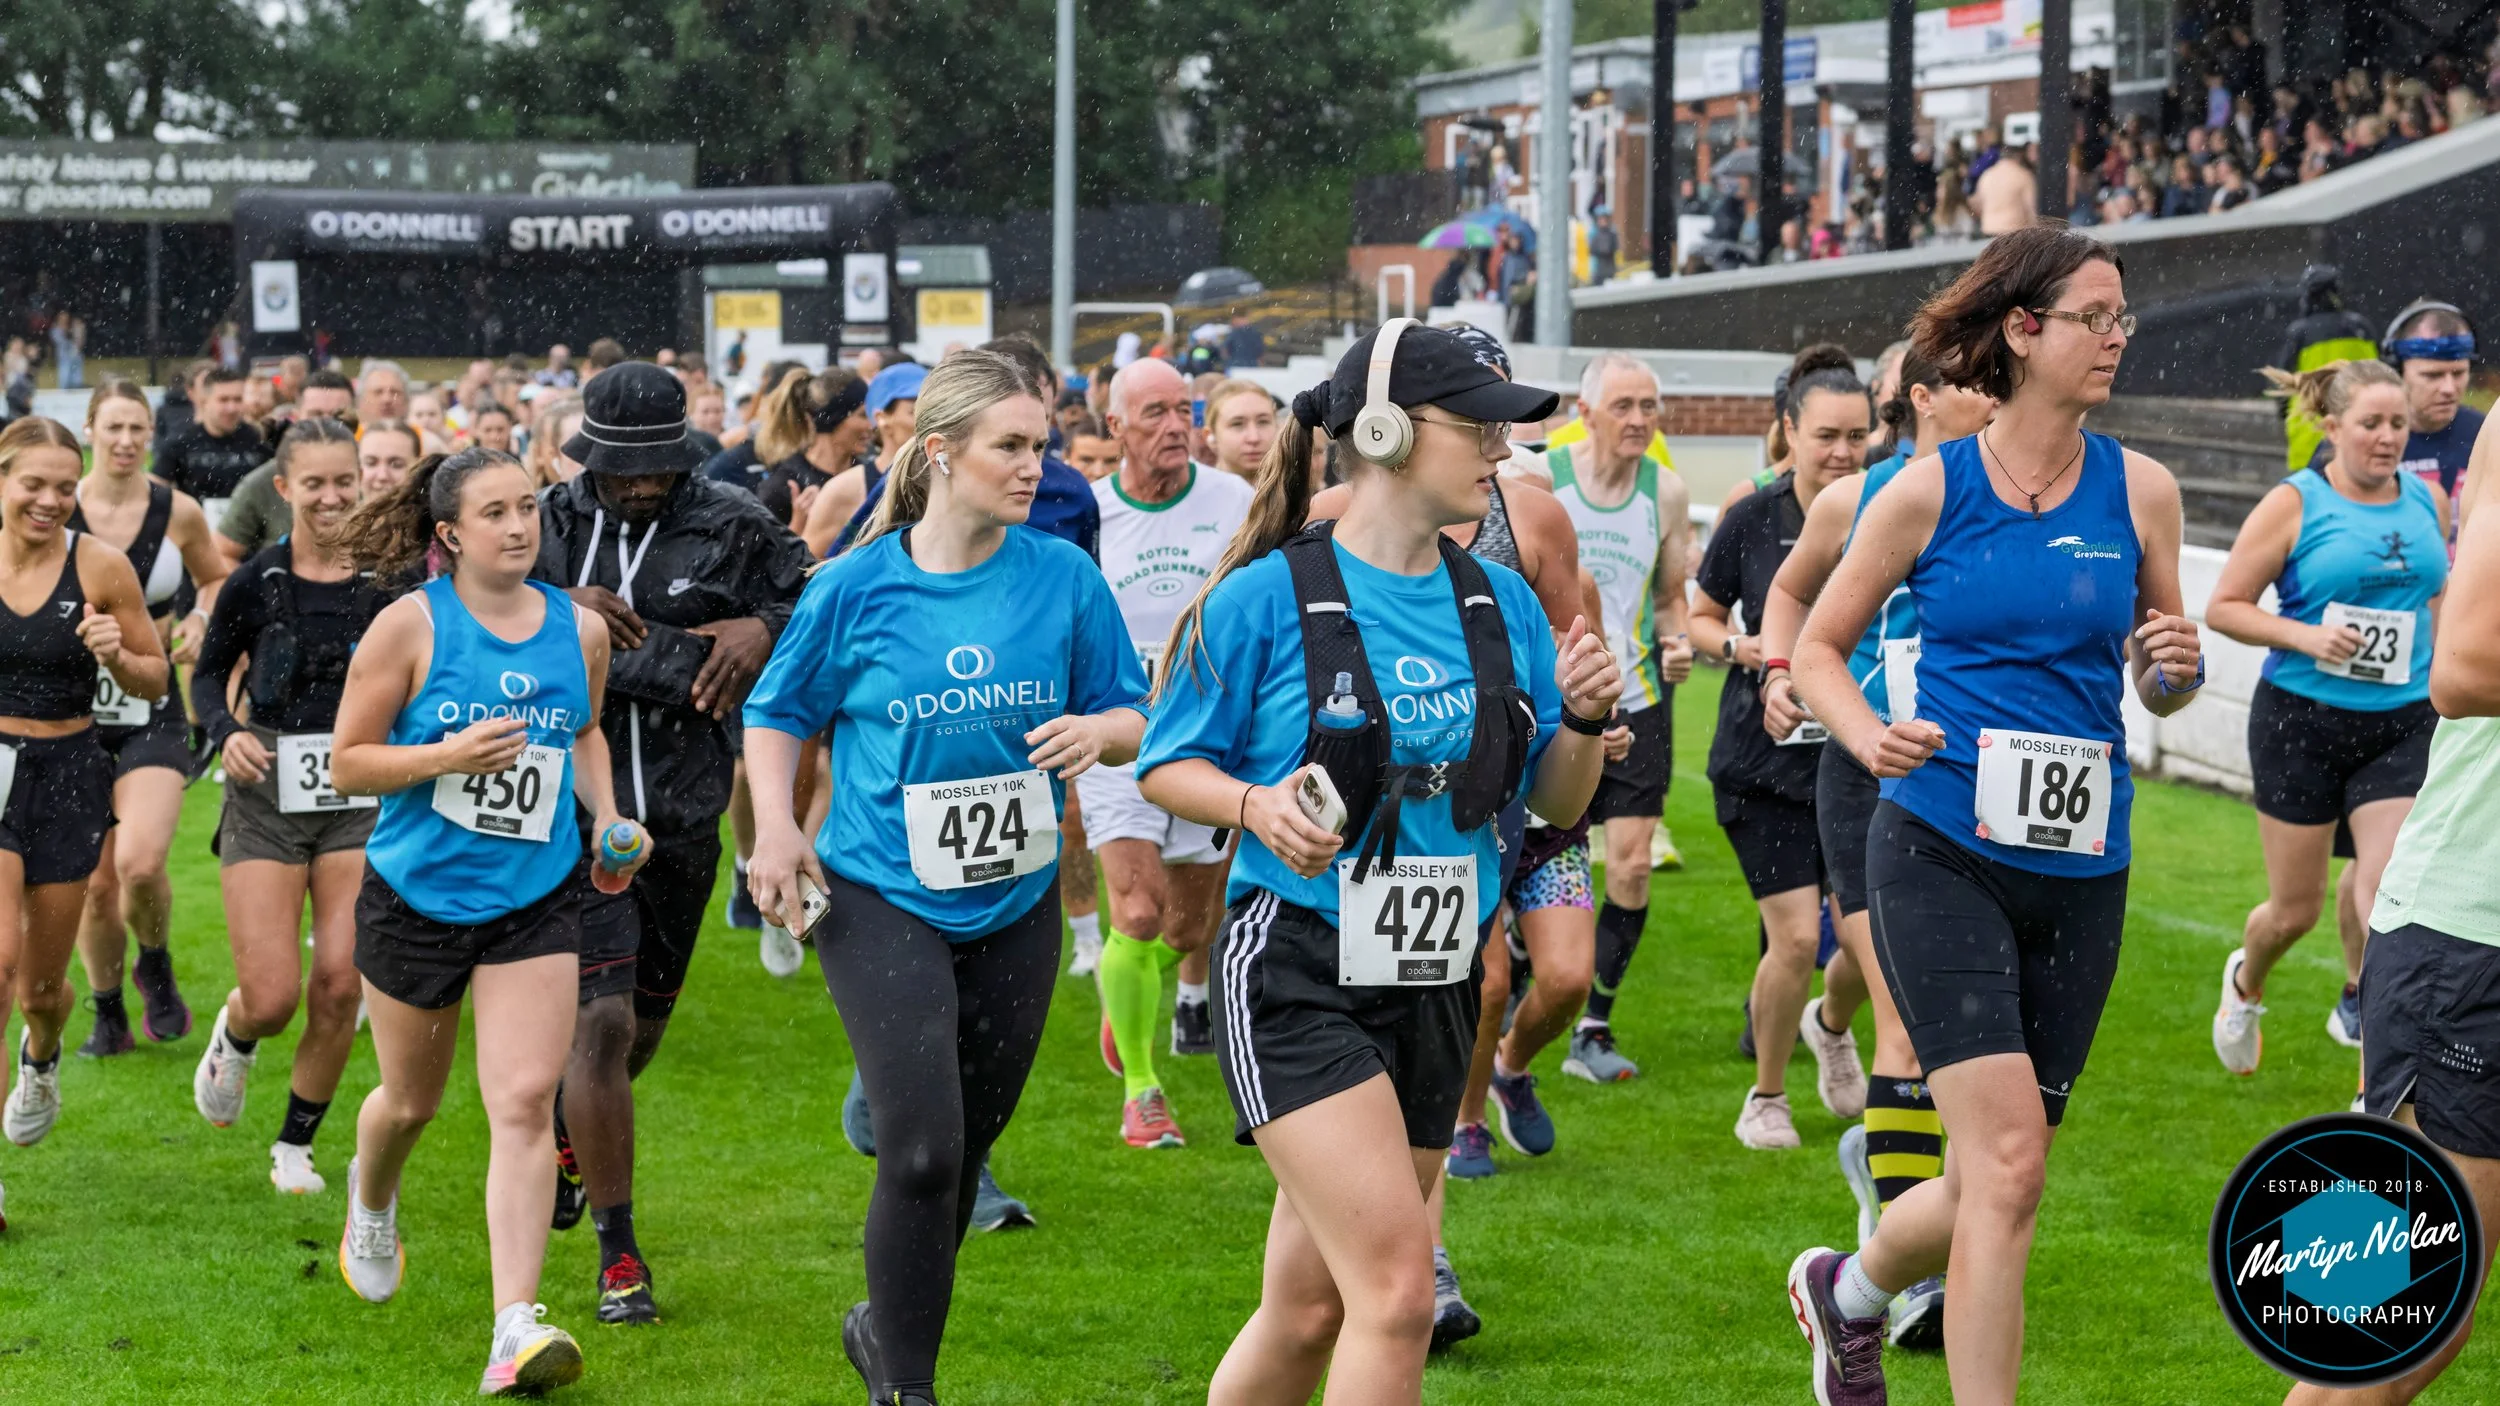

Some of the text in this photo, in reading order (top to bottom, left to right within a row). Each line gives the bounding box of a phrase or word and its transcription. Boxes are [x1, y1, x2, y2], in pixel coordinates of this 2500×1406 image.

[155, 154, 177, 181] &
[509, 215, 634, 252] START
[1136, 546, 1190, 562] ROYTON
[2074, 551, 2121, 560] Greyhounds
[1116, 567, 1150, 591] ROAD
[888, 680, 1058, 724] O'DONNELL
[936, 717, 1018, 736] SOLICITORS
[1393, 729, 1474, 748] OLICITORS
[2010, 738, 2101, 760] MOSSLEY 10K
[530, 751, 548, 762] 10K
[462, 764, 541, 815] 450
[930, 778, 1026, 800] MOSSLEY 10K
[2018, 758, 2092, 824] 186
[938, 797, 1028, 860] 424
[1371, 864, 1468, 878] MOSSLEY 10K
[1374, 885, 1465, 952] 422
